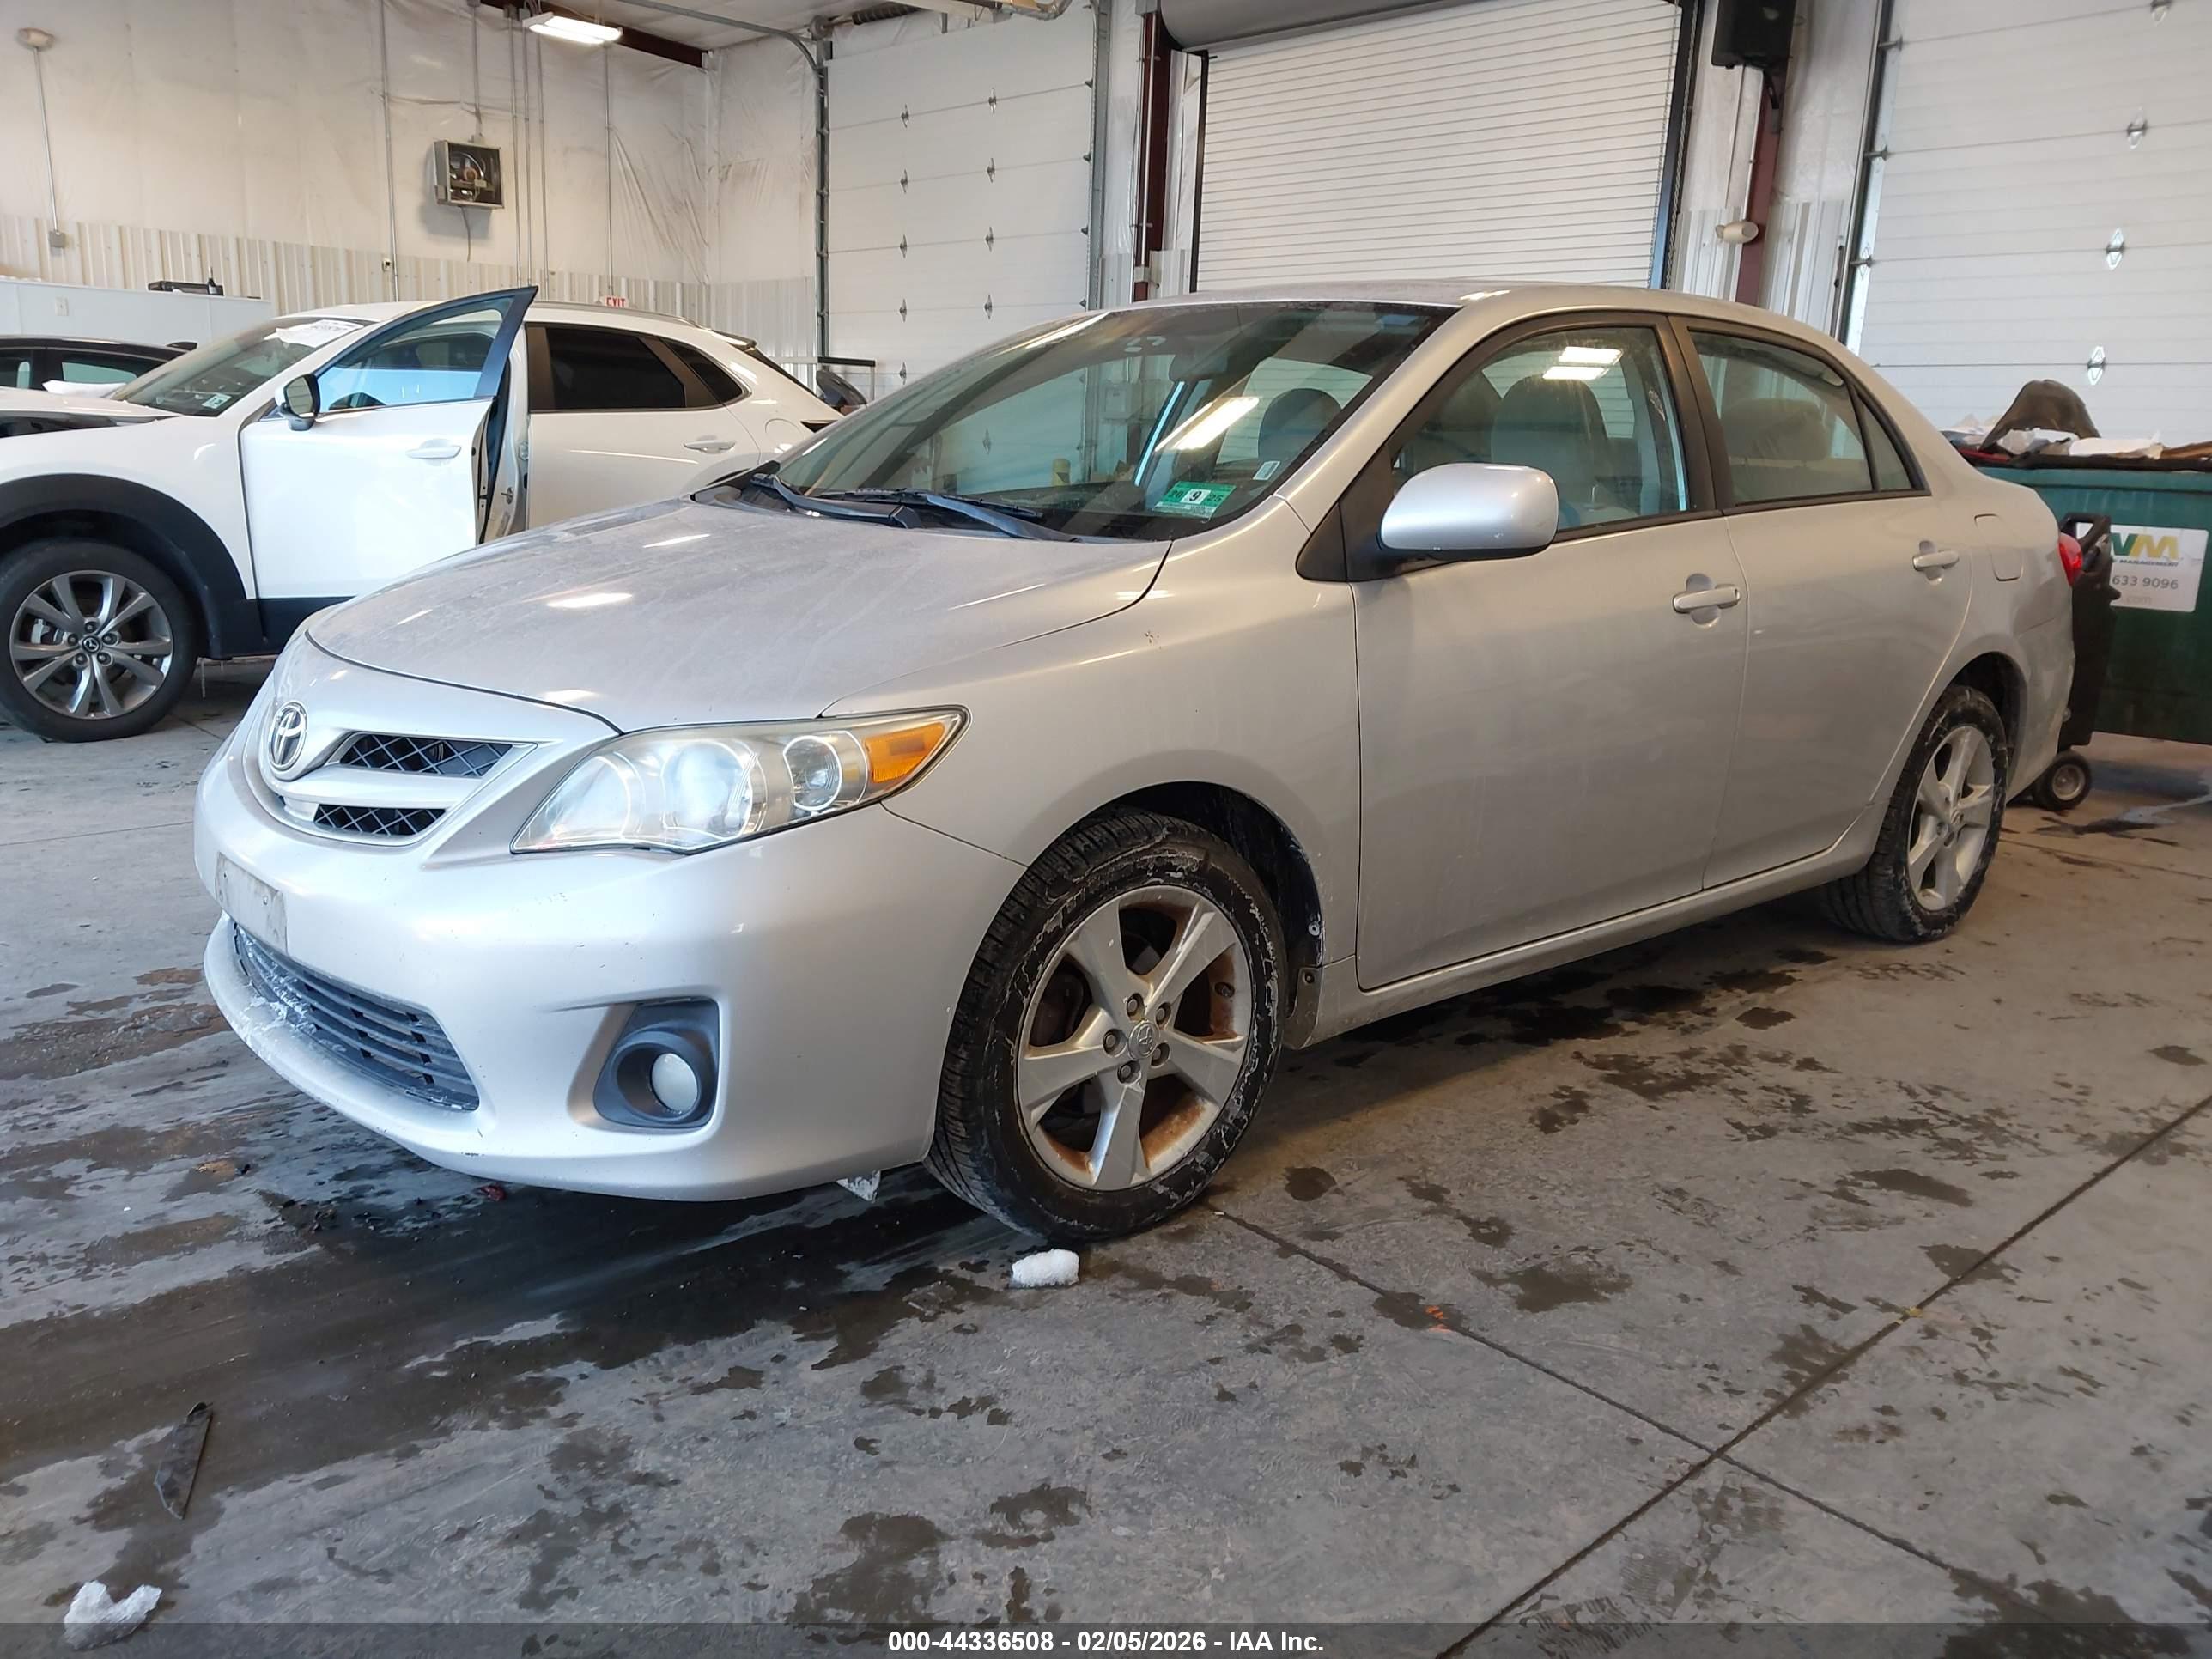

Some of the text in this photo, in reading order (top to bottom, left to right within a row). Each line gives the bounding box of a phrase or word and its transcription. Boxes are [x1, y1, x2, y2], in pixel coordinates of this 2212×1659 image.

[606, 296, 626, 307] EXIT
[1188, 490, 1203, 502] 9
[2112, 575, 2179, 590] 633 9096
